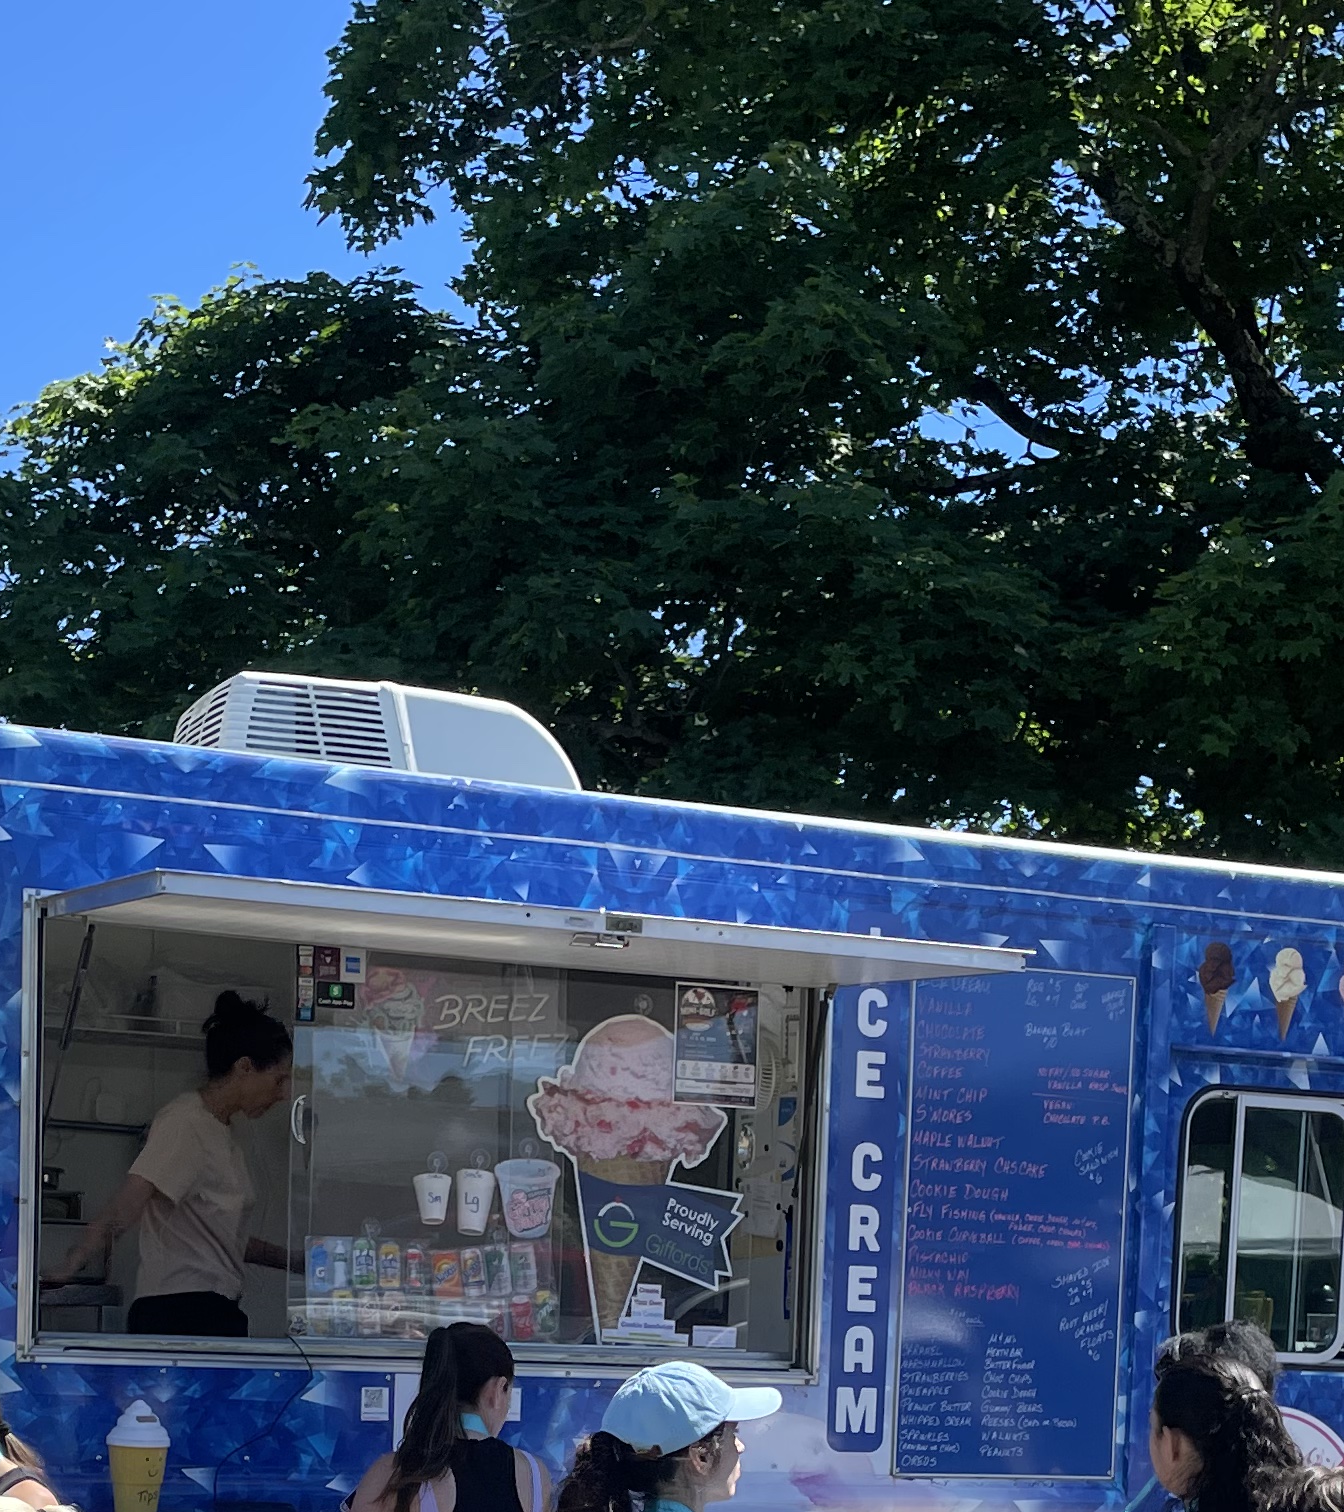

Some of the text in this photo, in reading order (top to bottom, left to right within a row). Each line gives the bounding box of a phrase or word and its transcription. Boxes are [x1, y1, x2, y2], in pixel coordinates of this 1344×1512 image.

[433, 993, 550, 1030] BREEZ
[917, 996, 974, 1017] VANILLA
[917, 1020, 985, 1040] CHOCOLATE
[1025, 1022, 1057, 1037] BANANA
[917, 1061, 965, 1079] COFFEE
[915, 1085, 988, 1104] MINT CHIP
[915, 1104, 973, 1124] S'MORES
[912, 1130, 1006, 1150] MAPLE WALNUT
[912, 1153, 987, 1178] STRAWBERRY
[910, 1179, 1009, 1202] COOKIE DOUGH
[465, 1192, 480, 1214] Lg
[911, 1200, 934, 1222] FLY
[941, 1203, 986, 1223] FISHING
[666, 1197, 719, 1232] Proudly
[662, 1212, 714, 1247] Serving
[908, 1224, 943, 1242] COOKIE
[947, 1226, 1005, 1245] CURVEBALL
[908, 1245, 969, 1264] PISTACHIO
[947, 1268, 970, 1283] WAY
[1051, 1266, 1089, 1289] SHAVED
[835, 1141, 883, 1434] CREAM
[1080, 1329, 1115, 1350] FLOATS
[901, 1370, 969, 1384] STRAWBERRIES
[900, 1414, 941, 1427] WHIPPED
[980, 1414, 1016, 1428] REESES
[981, 1431, 1031, 1442] WALNUTS
[900, 1454, 937, 1467] OREOS
[979, 1444, 1024, 1458] PEANUTS
[137, 1489, 158, 1506] Tips
